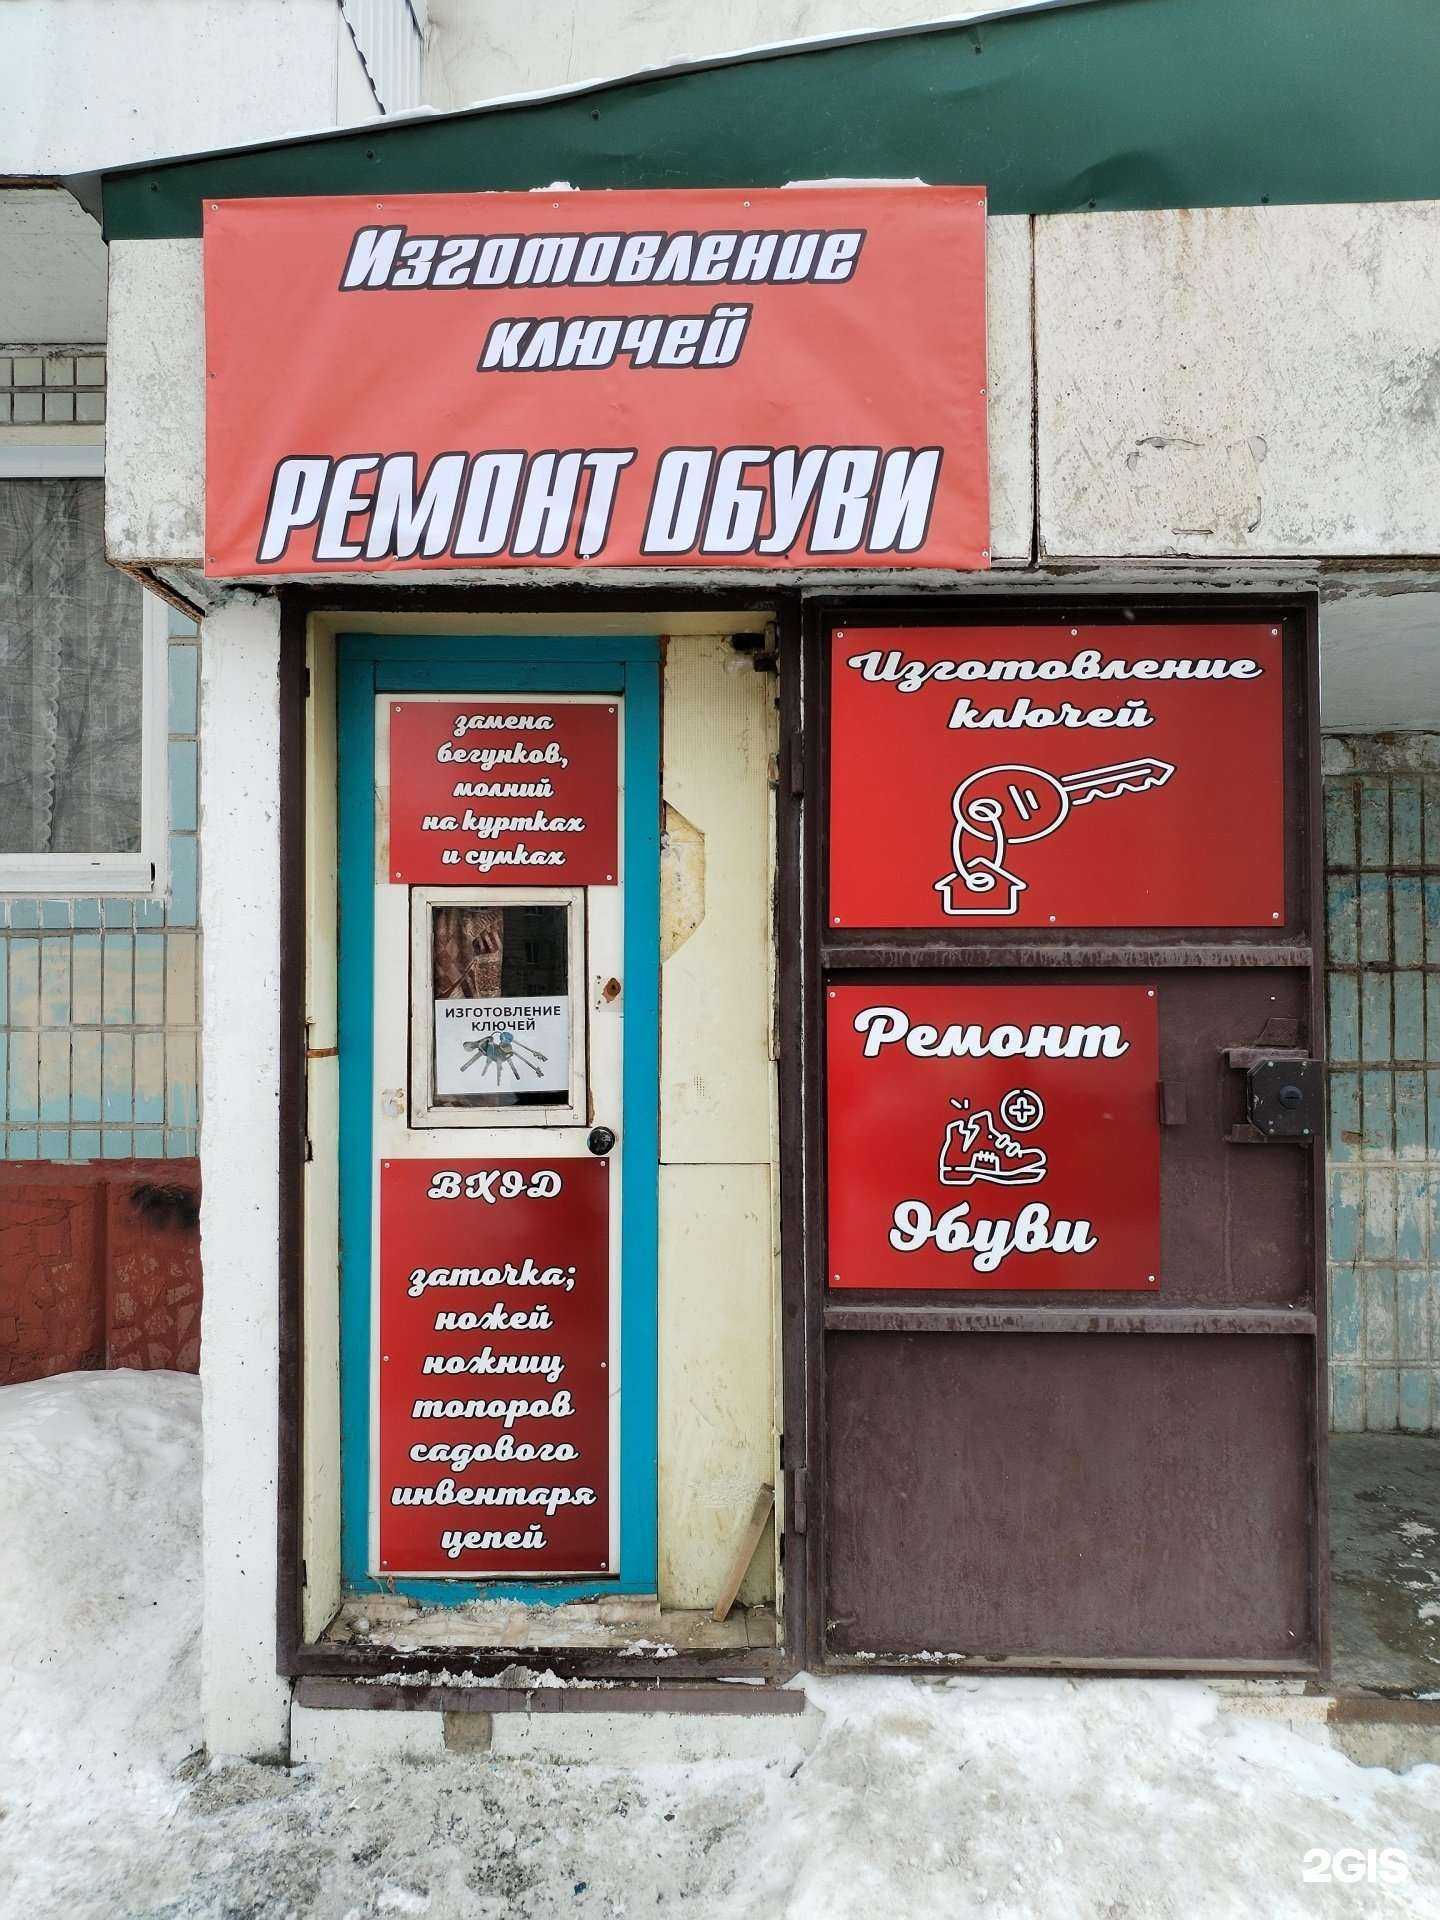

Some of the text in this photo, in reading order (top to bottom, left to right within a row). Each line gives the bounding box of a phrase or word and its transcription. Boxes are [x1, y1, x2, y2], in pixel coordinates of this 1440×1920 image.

[339, 225, 867, 291] Изготовление
[477, 303, 752, 372] ключей
[257, 446, 944, 564] РЕМОНТ ОБУВИ
[847, 649, 1264, 693] Изготовление
[453, 714, 554, 737] замена
[947, 697, 1154, 730] ключей
[437, 741, 568, 771] бегунков,
[453, 778, 554, 798] молний
[422, 809, 585, 839] на куртках
[441, 843, 566, 873] и сумках
[445, 1005, 561, 1018] ИЗГОТОВЛЕНИЕ
[471, 1018, 536, 1032] КЛЮЧЕЙ
[853, 1005, 1129, 1059] Ремонт
[427, 1169, 562, 1205] ВХОД
[888, 1199, 1098, 1273] Обуви
[407, 1258, 576, 1297] заточка;
[434, 1302, 553, 1331] ножей
[422, 1346, 565, 1383] ножниц
[411, 1390, 575, 1428] топоров
[409, 1433, 579, 1472] садового
[391, 1478, 597, 1516] инвентаря
[440, 1523, 547, 1559] цепей
